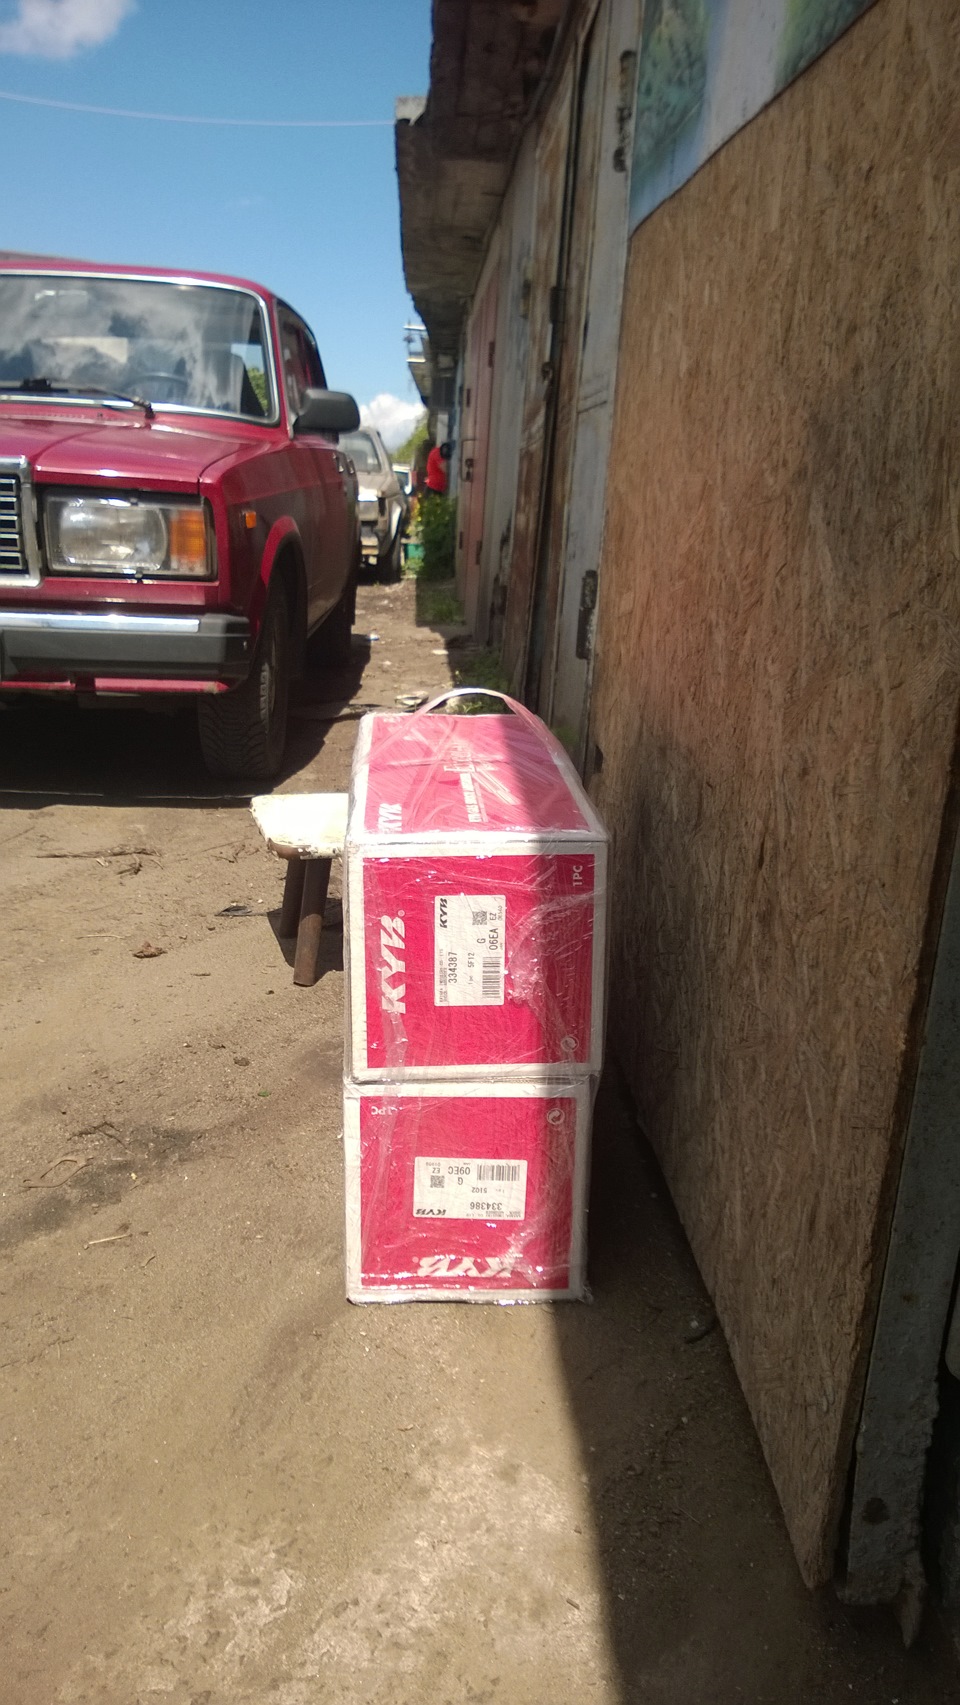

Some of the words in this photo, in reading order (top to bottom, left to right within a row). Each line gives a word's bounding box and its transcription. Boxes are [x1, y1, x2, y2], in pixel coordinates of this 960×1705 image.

[573, 865, 583, 886] 1PC
[490, 912, 497, 921] EZ
[489, 928, 498, 950] 06EA
[381, 915, 405, 1014] KYB
[448, 952, 457, 983] 334387
[448, 1166, 471, 1175] 09EC
[458, 1177, 464, 1185] G
[470, 1202, 503, 1211] 334386
[417, 1257, 514, 1278] KYB
